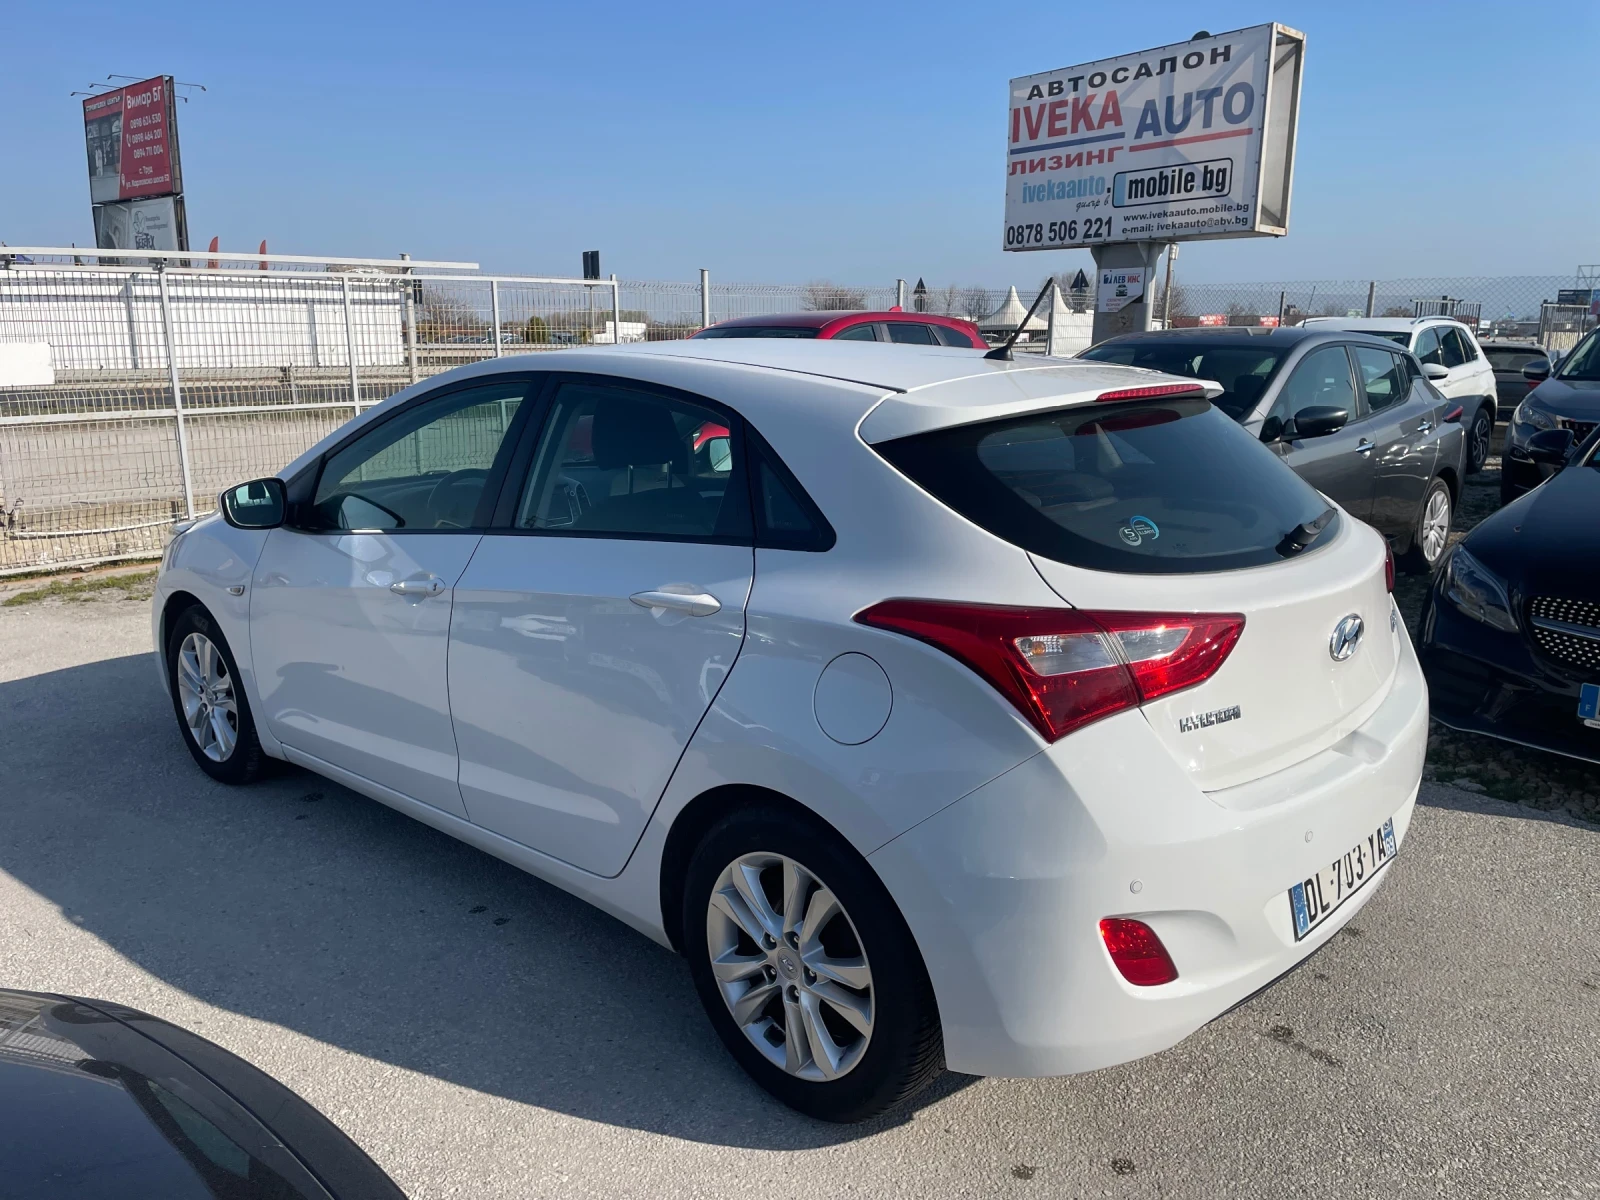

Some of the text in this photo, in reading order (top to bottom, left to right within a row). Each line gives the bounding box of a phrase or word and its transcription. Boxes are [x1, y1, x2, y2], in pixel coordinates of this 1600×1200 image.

[1027, 44, 1232, 100] АВТОСАЛОН
[126, 85, 162, 109] Вимар БГ
[1011, 81, 1255, 143] IVEKA AUTO
[1009, 146, 1124, 176] ЛИЗИНГ
[1127, 165, 1228, 200] mobile.bg
[1121, 215, 1249, 235] e-mail: ivekaauto@abv.bg
[1123, 202, 1250, 222] www.ivekaauto.mobile.bg
[1006, 216, 1113, 245] 0878 506 221
